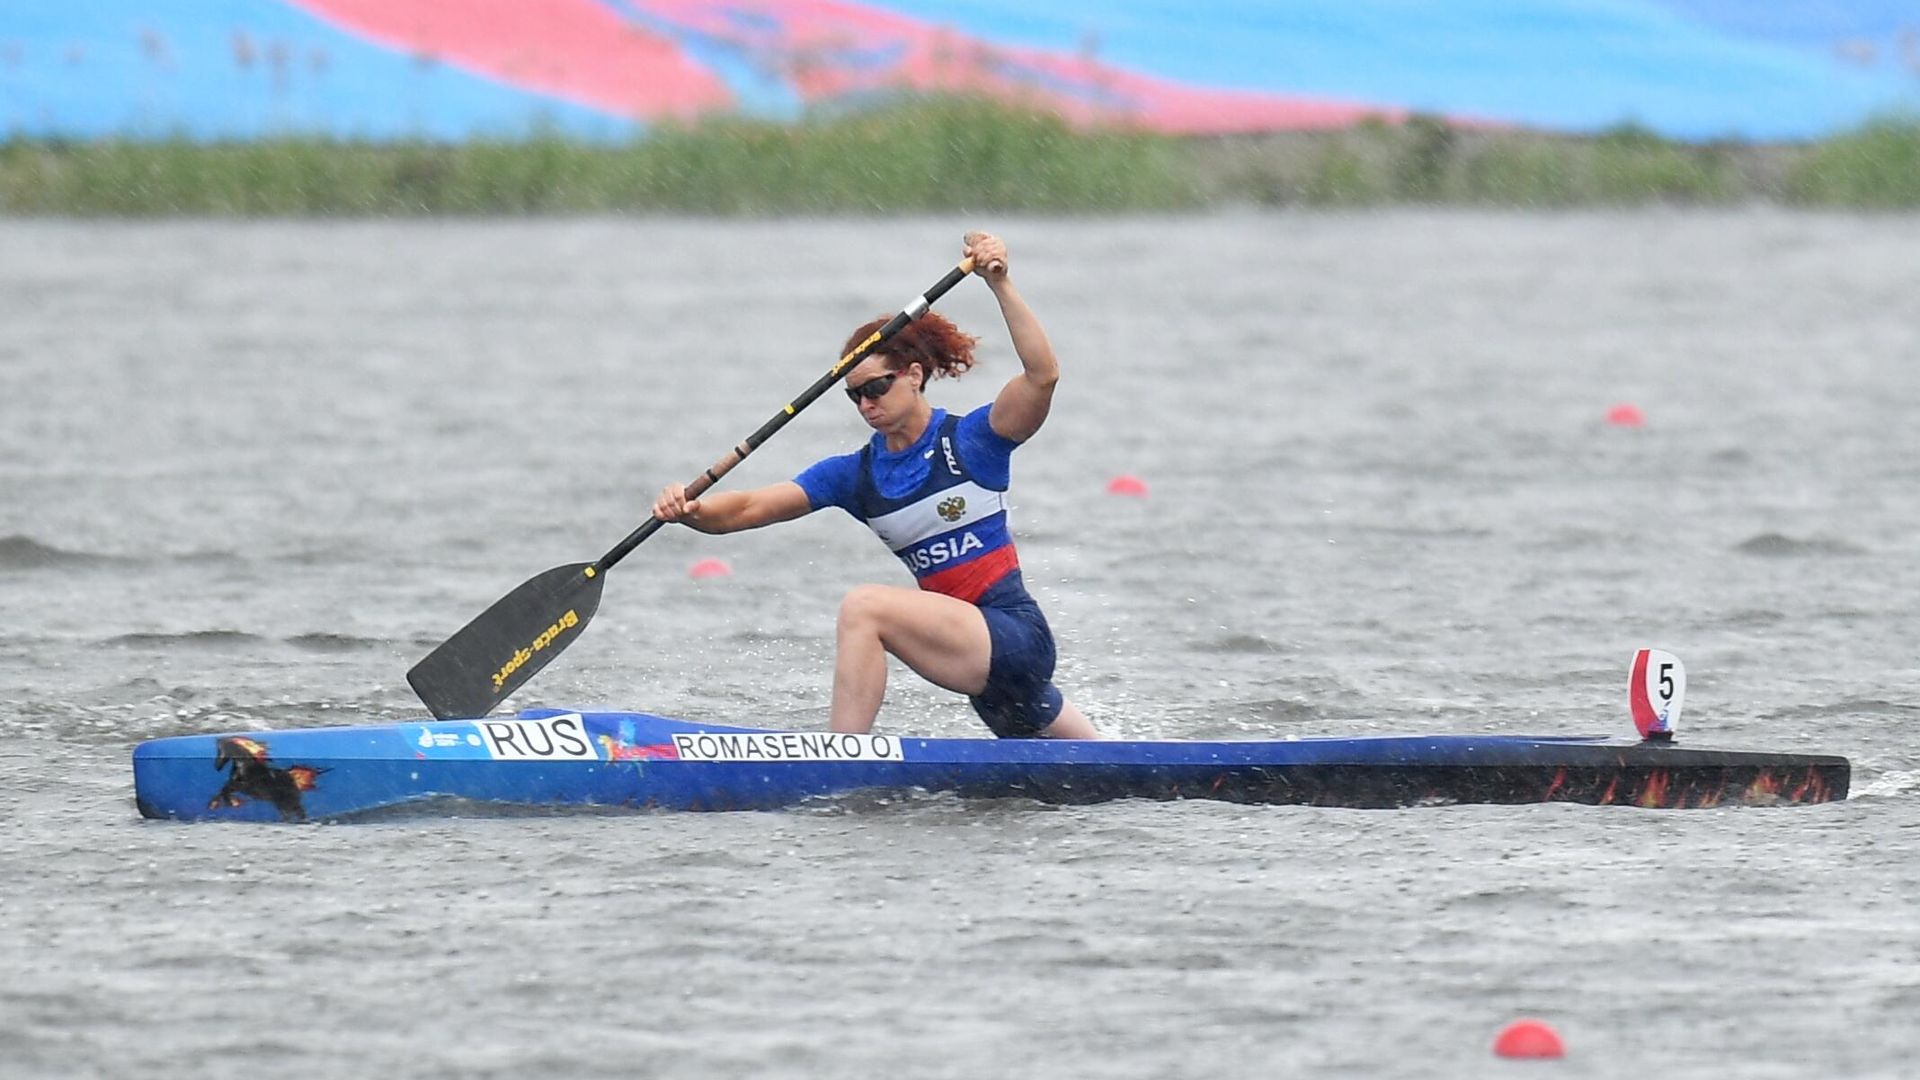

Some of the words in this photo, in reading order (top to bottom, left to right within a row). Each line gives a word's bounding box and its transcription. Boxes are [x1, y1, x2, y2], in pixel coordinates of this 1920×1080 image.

[902, 531, 984, 572] USSIA
[1659, 663, 1674, 700] 5
[483, 718, 588, 757] RUS
[675, 734, 862, 759] ROMASENKO
[870, 735, 900, 759] O.
